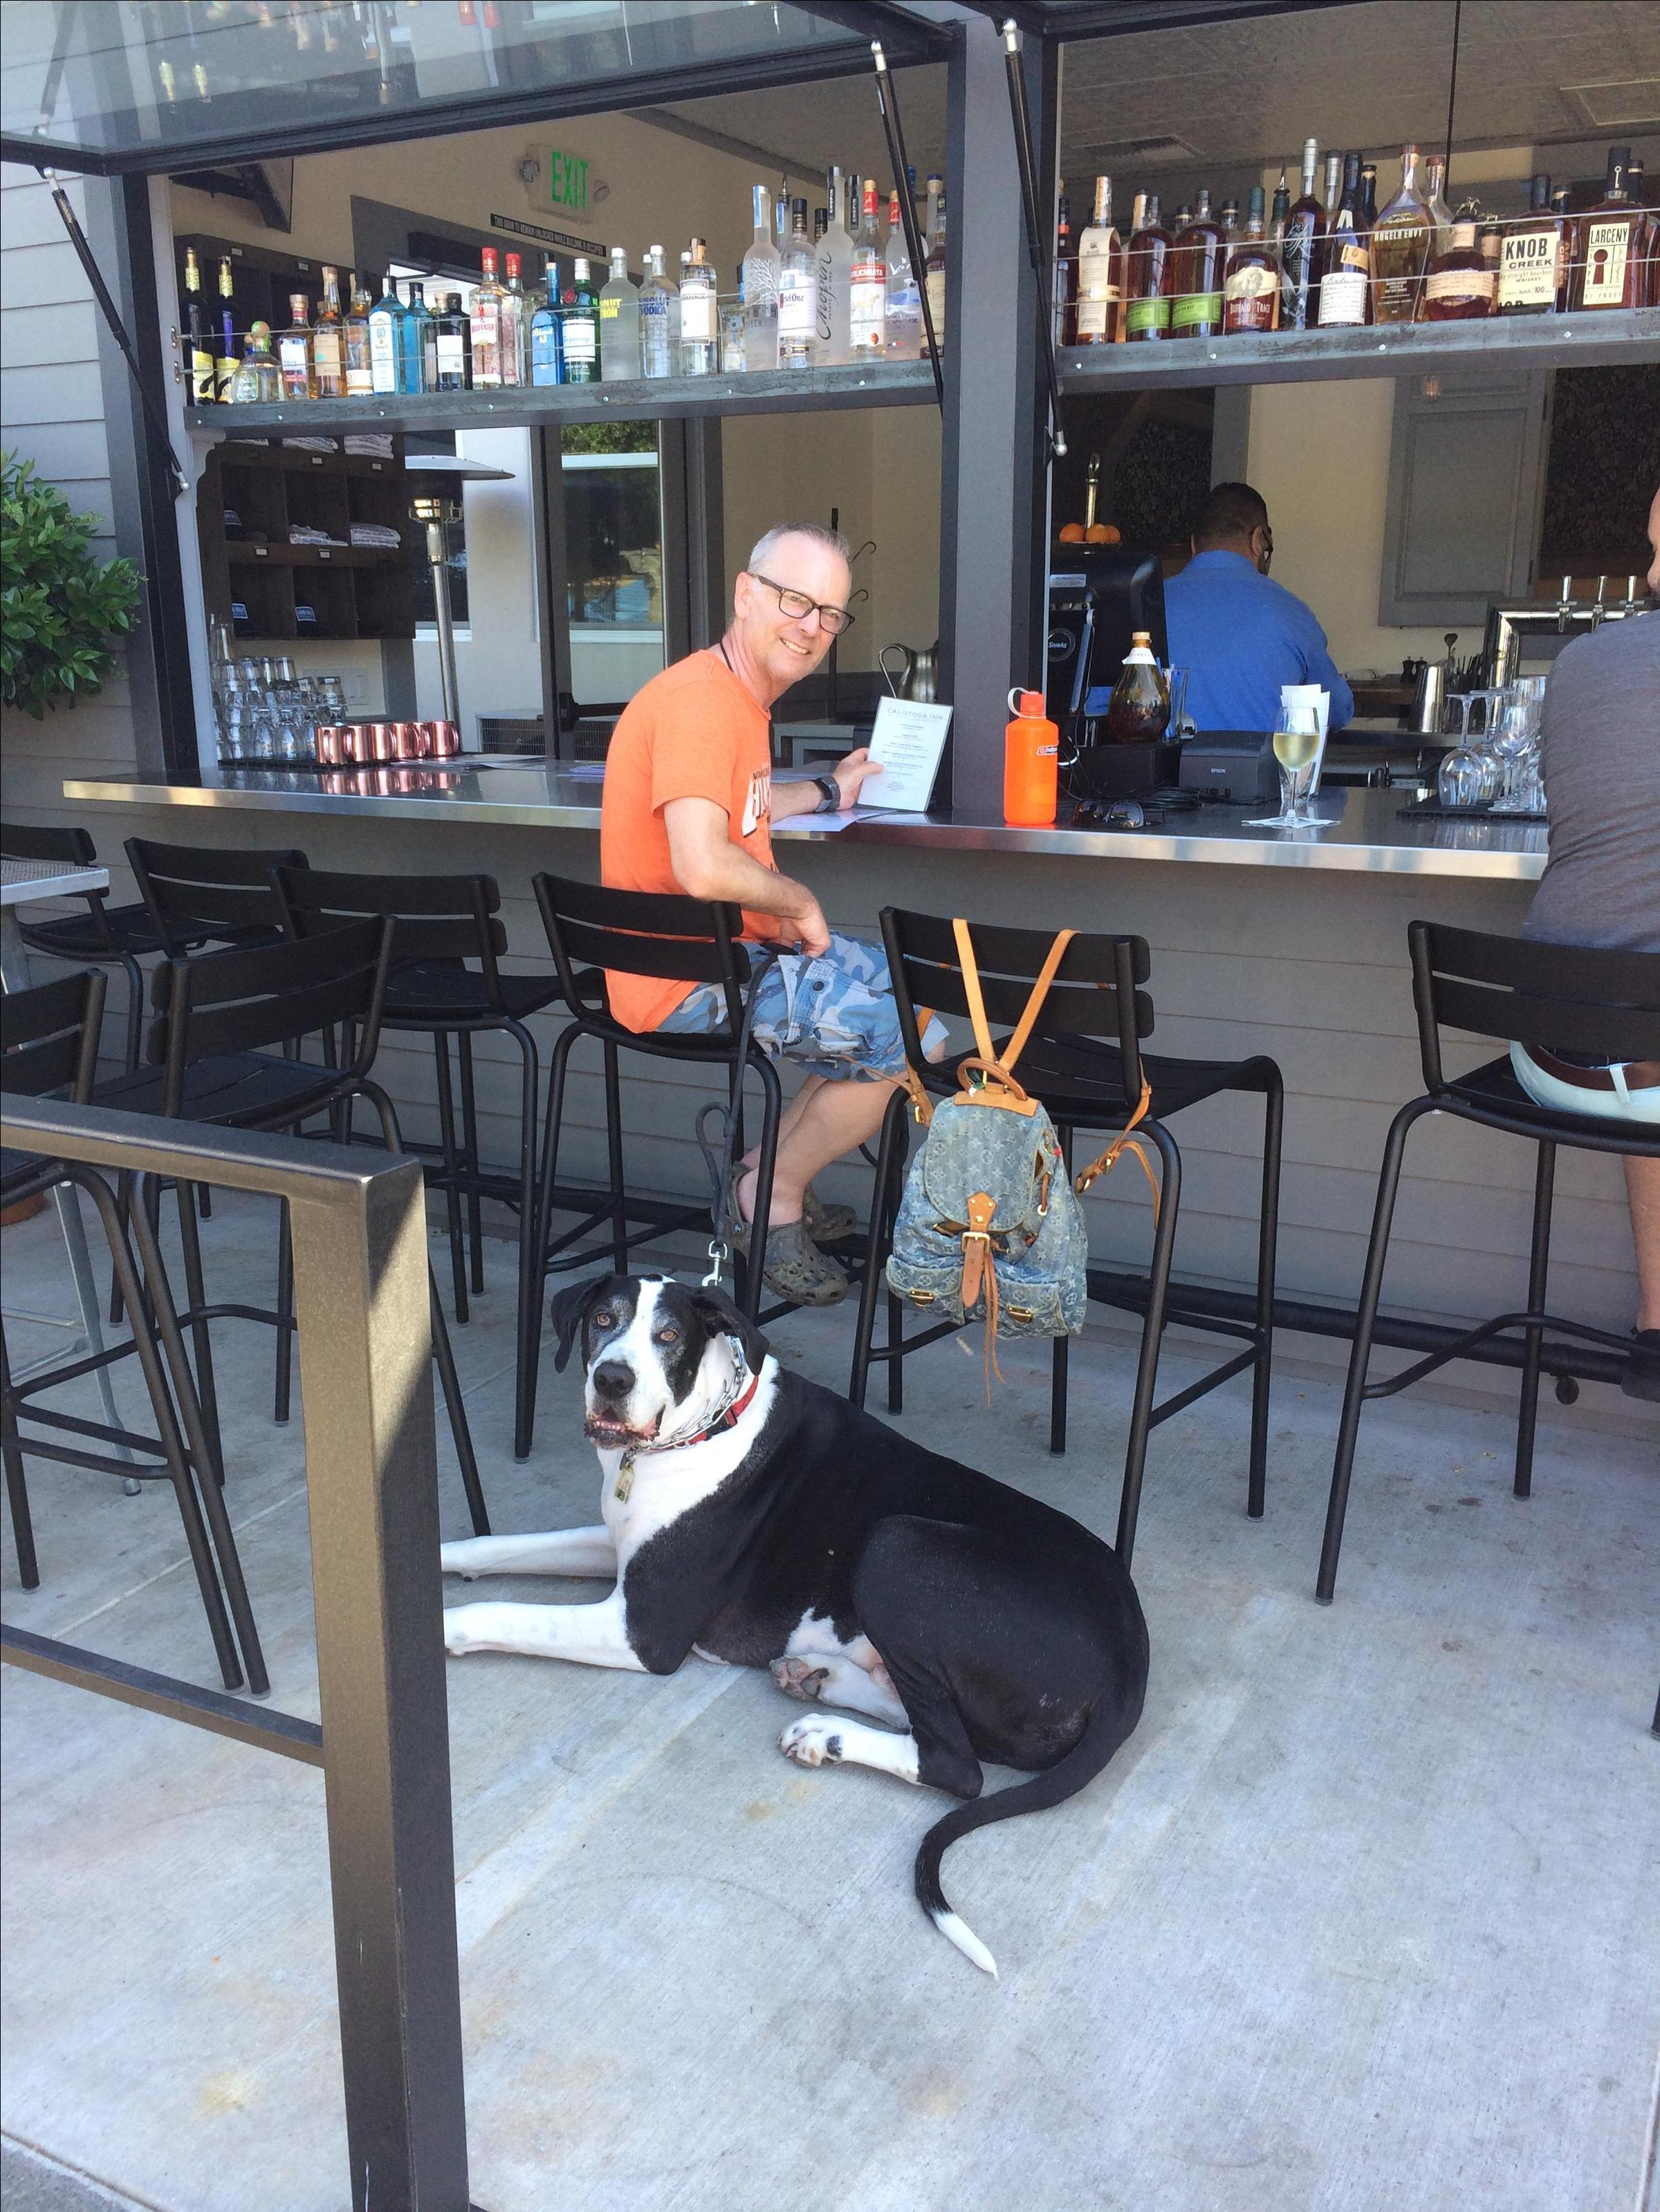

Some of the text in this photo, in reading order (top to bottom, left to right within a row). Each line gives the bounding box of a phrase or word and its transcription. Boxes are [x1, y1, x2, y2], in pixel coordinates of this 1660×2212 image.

[551, 151, 589, 210] EXIT
[504, 219, 514, 230] DOOR
[521, 223, 534, 236] REMAIN
[535, 227, 553, 241] UNLOCKED
[1404, 229, 1423, 239] ENVY
[1591, 227, 1627, 244] LARCENY
[1506, 238, 1548, 261] KNOB
[1509, 259, 1553, 269] CREEK
[816, 252, 838, 340] Chopin
[640, 306, 667, 315] VODKA
[471, 324, 495, 333] BEEFEATER
[887, 707, 927, 718] CALISTOGA
